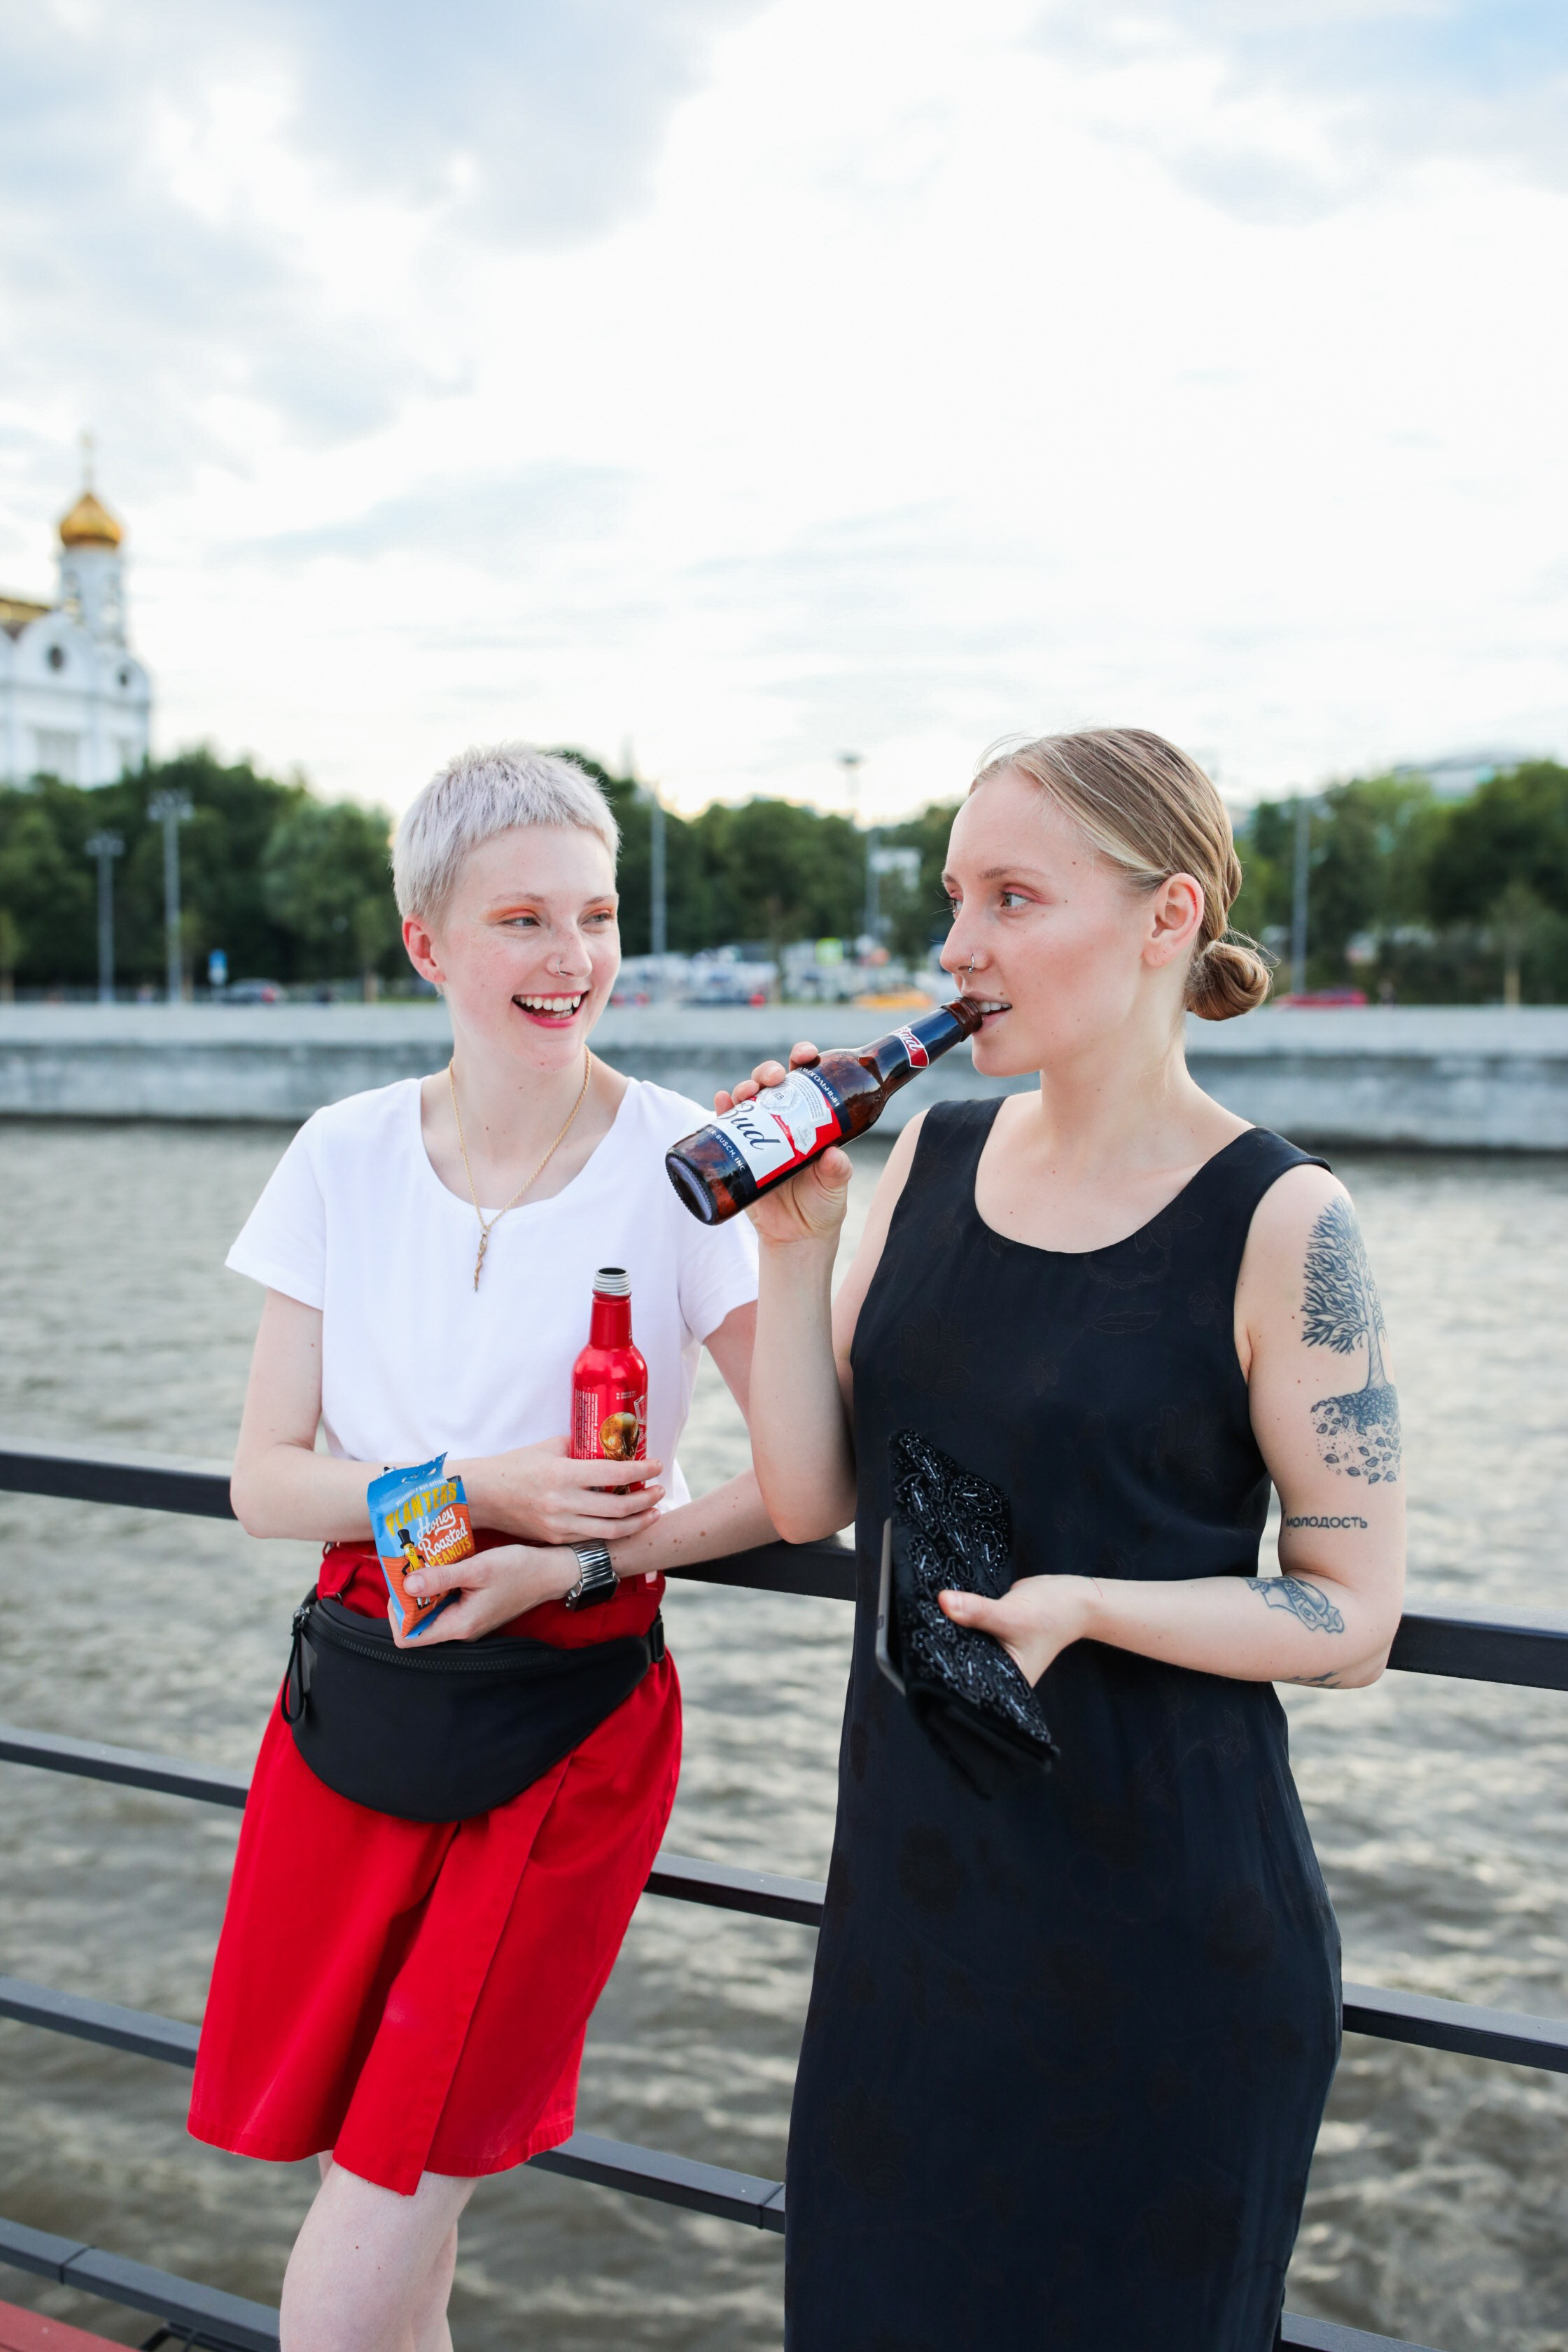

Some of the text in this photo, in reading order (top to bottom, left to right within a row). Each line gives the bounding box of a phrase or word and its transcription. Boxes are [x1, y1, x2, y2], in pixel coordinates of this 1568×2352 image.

[717, 1102, 781, 1150] Bud
[386, 1482, 457, 1536] PLANTERS
[418, 1507, 456, 1539] Honey
[418, 1518, 468, 1561] Roasted
[429, 1537, 471, 1567] PEANUTS
